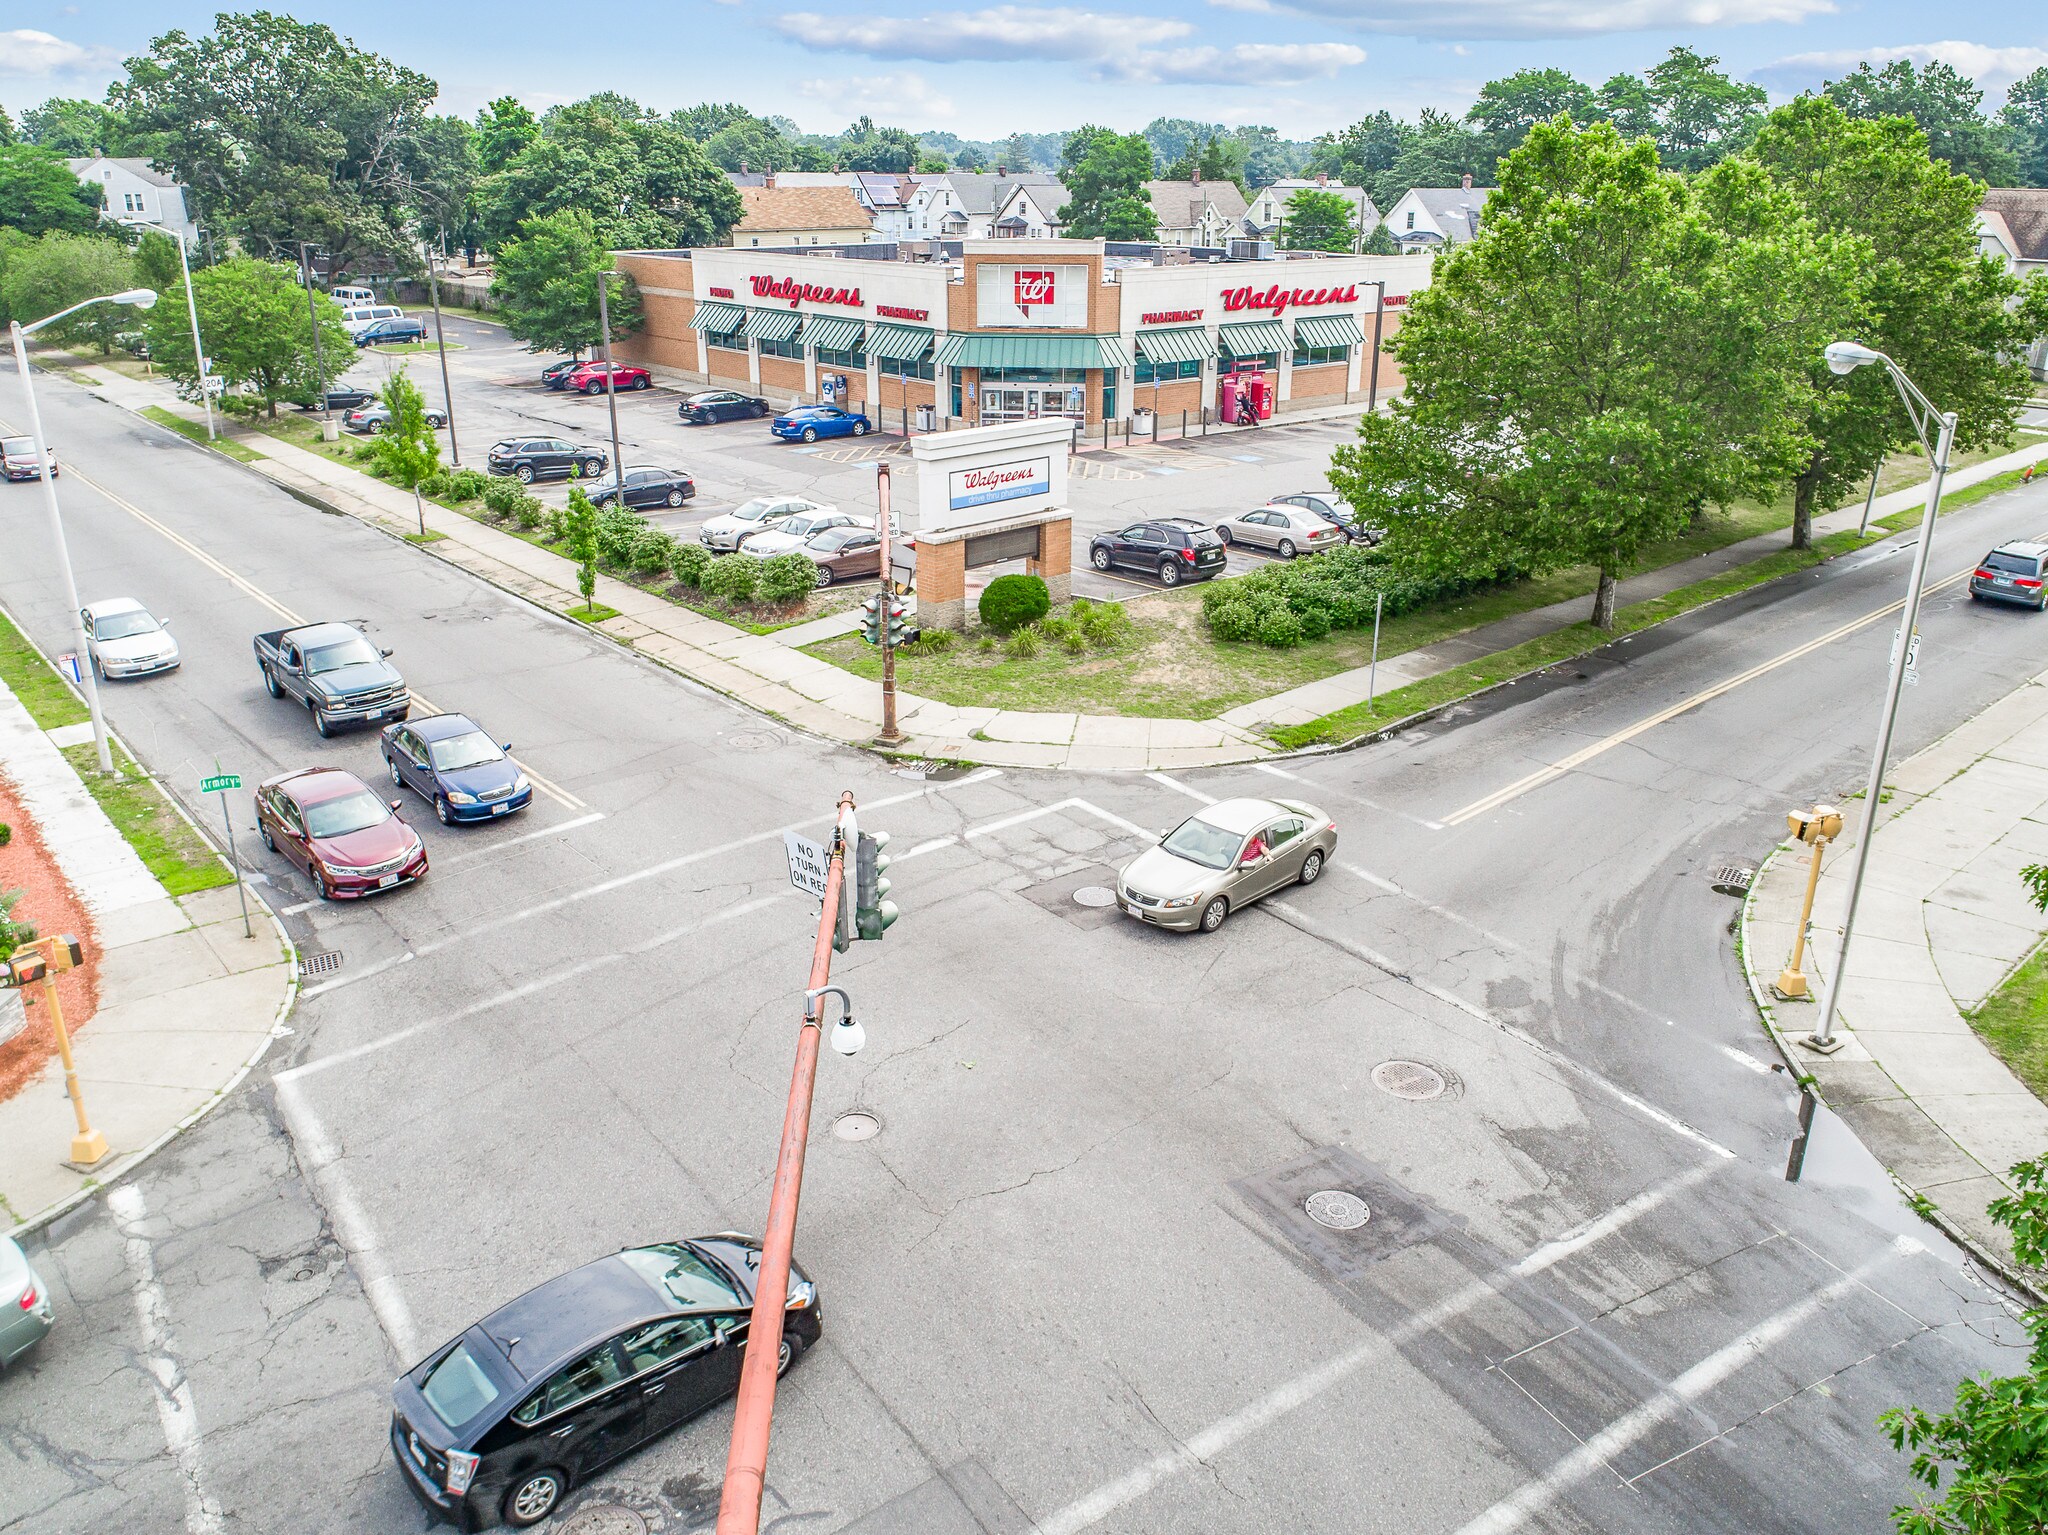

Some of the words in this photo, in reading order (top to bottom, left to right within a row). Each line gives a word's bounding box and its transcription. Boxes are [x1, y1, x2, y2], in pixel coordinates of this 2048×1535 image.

[750, 275, 864, 308] Walgreens
[1221, 284, 1359, 316] Walgreens
[877, 305, 929, 321] PHARMACY
[1142, 309, 1204, 324] PHARMACY
[206, 379, 222, 387] 20A
[964, 467, 1034, 490] Walgreens
[969, 495, 986, 503] drive
[1001, 486, 1032, 498] pharmacy
[202, 777, 235, 790] Armory
[797, 842, 814, 858] NO
[795, 856, 821, 877] TURN
[793, 870, 807, 885] ON
